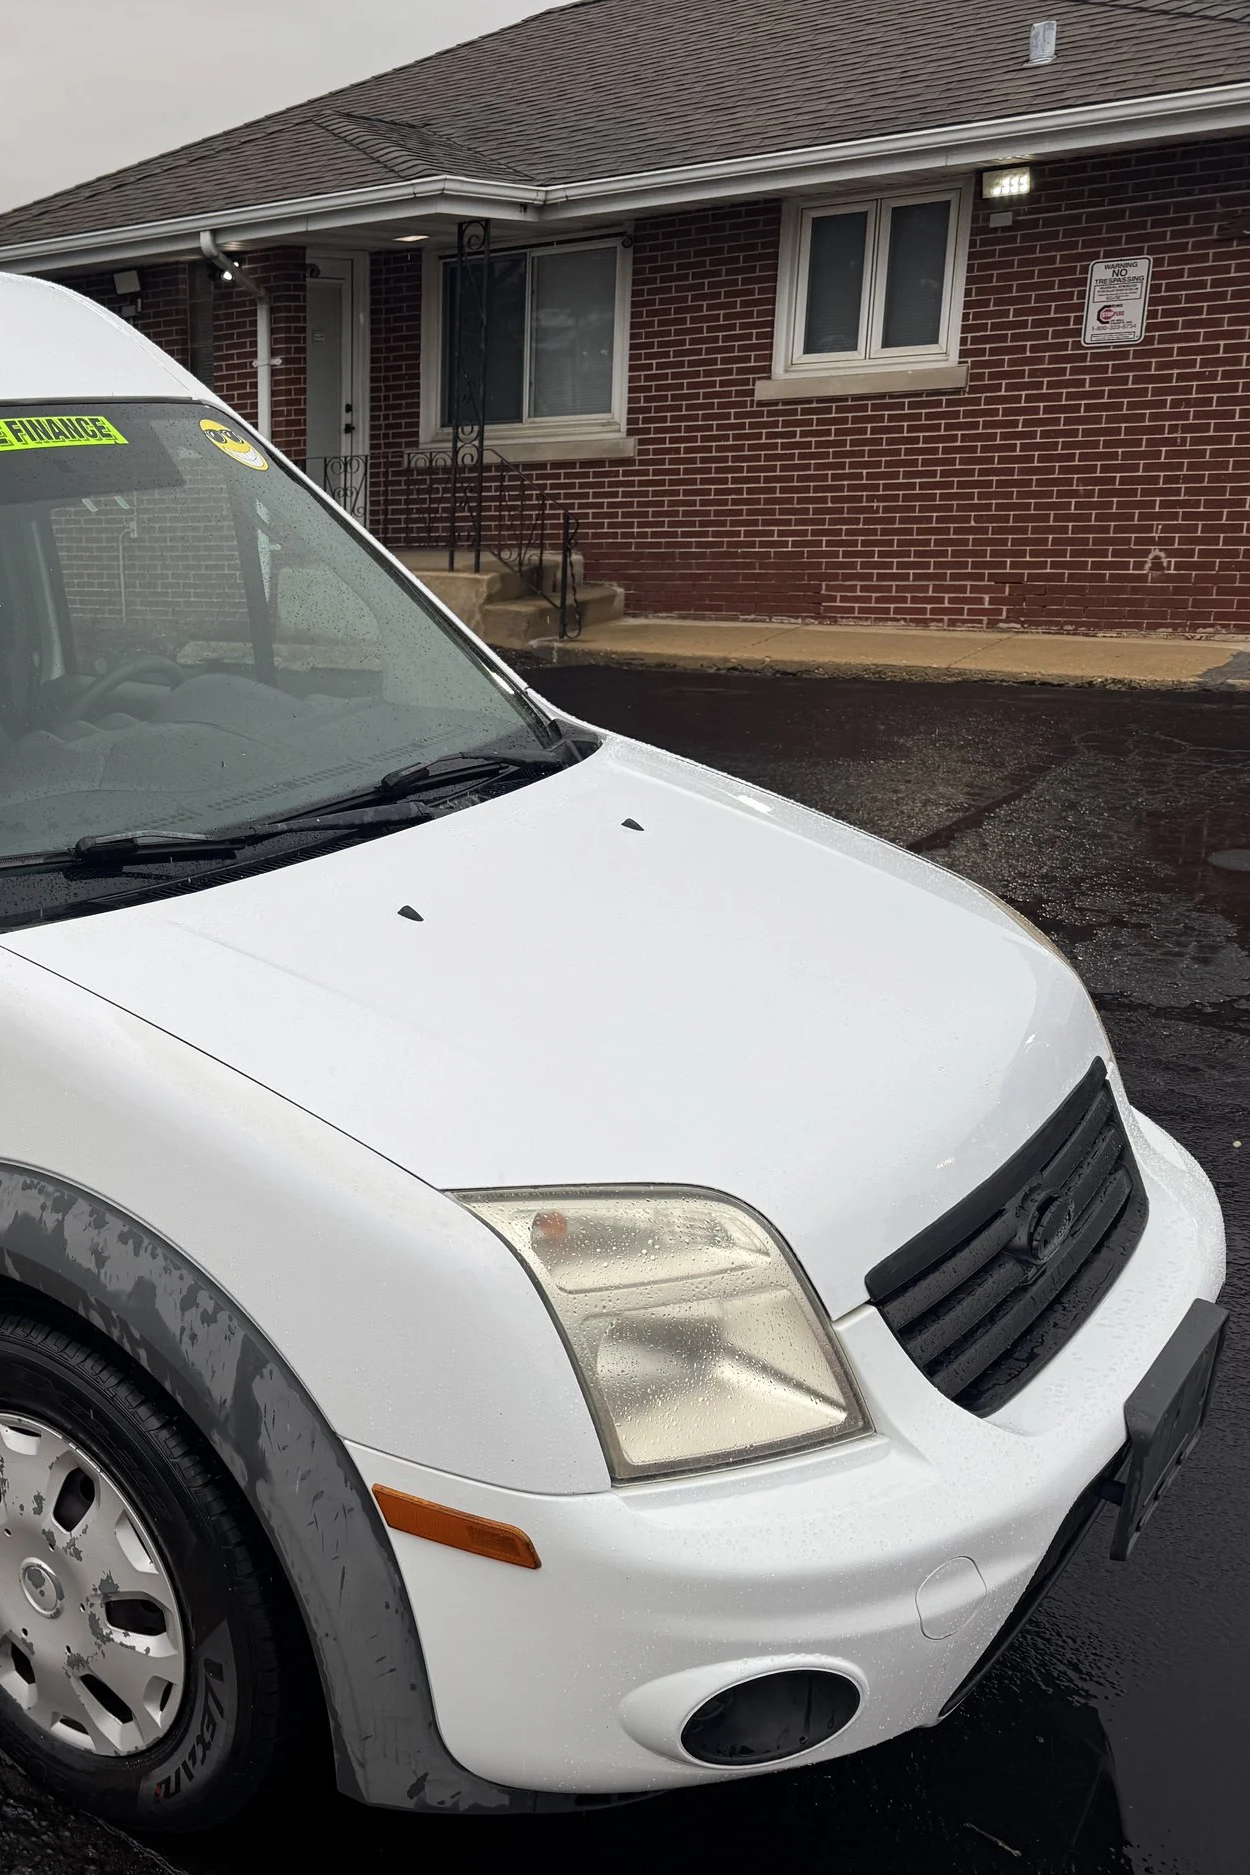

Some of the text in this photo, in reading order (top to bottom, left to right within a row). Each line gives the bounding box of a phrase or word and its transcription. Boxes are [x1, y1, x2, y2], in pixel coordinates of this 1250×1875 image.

[1104, 261, 1138, 270] WARNING
[1111, 268, 1128, 277] NO
[1094, 275, 1145, 285] TRESPASSING
[4, 417, 116, 445] FINANCE
